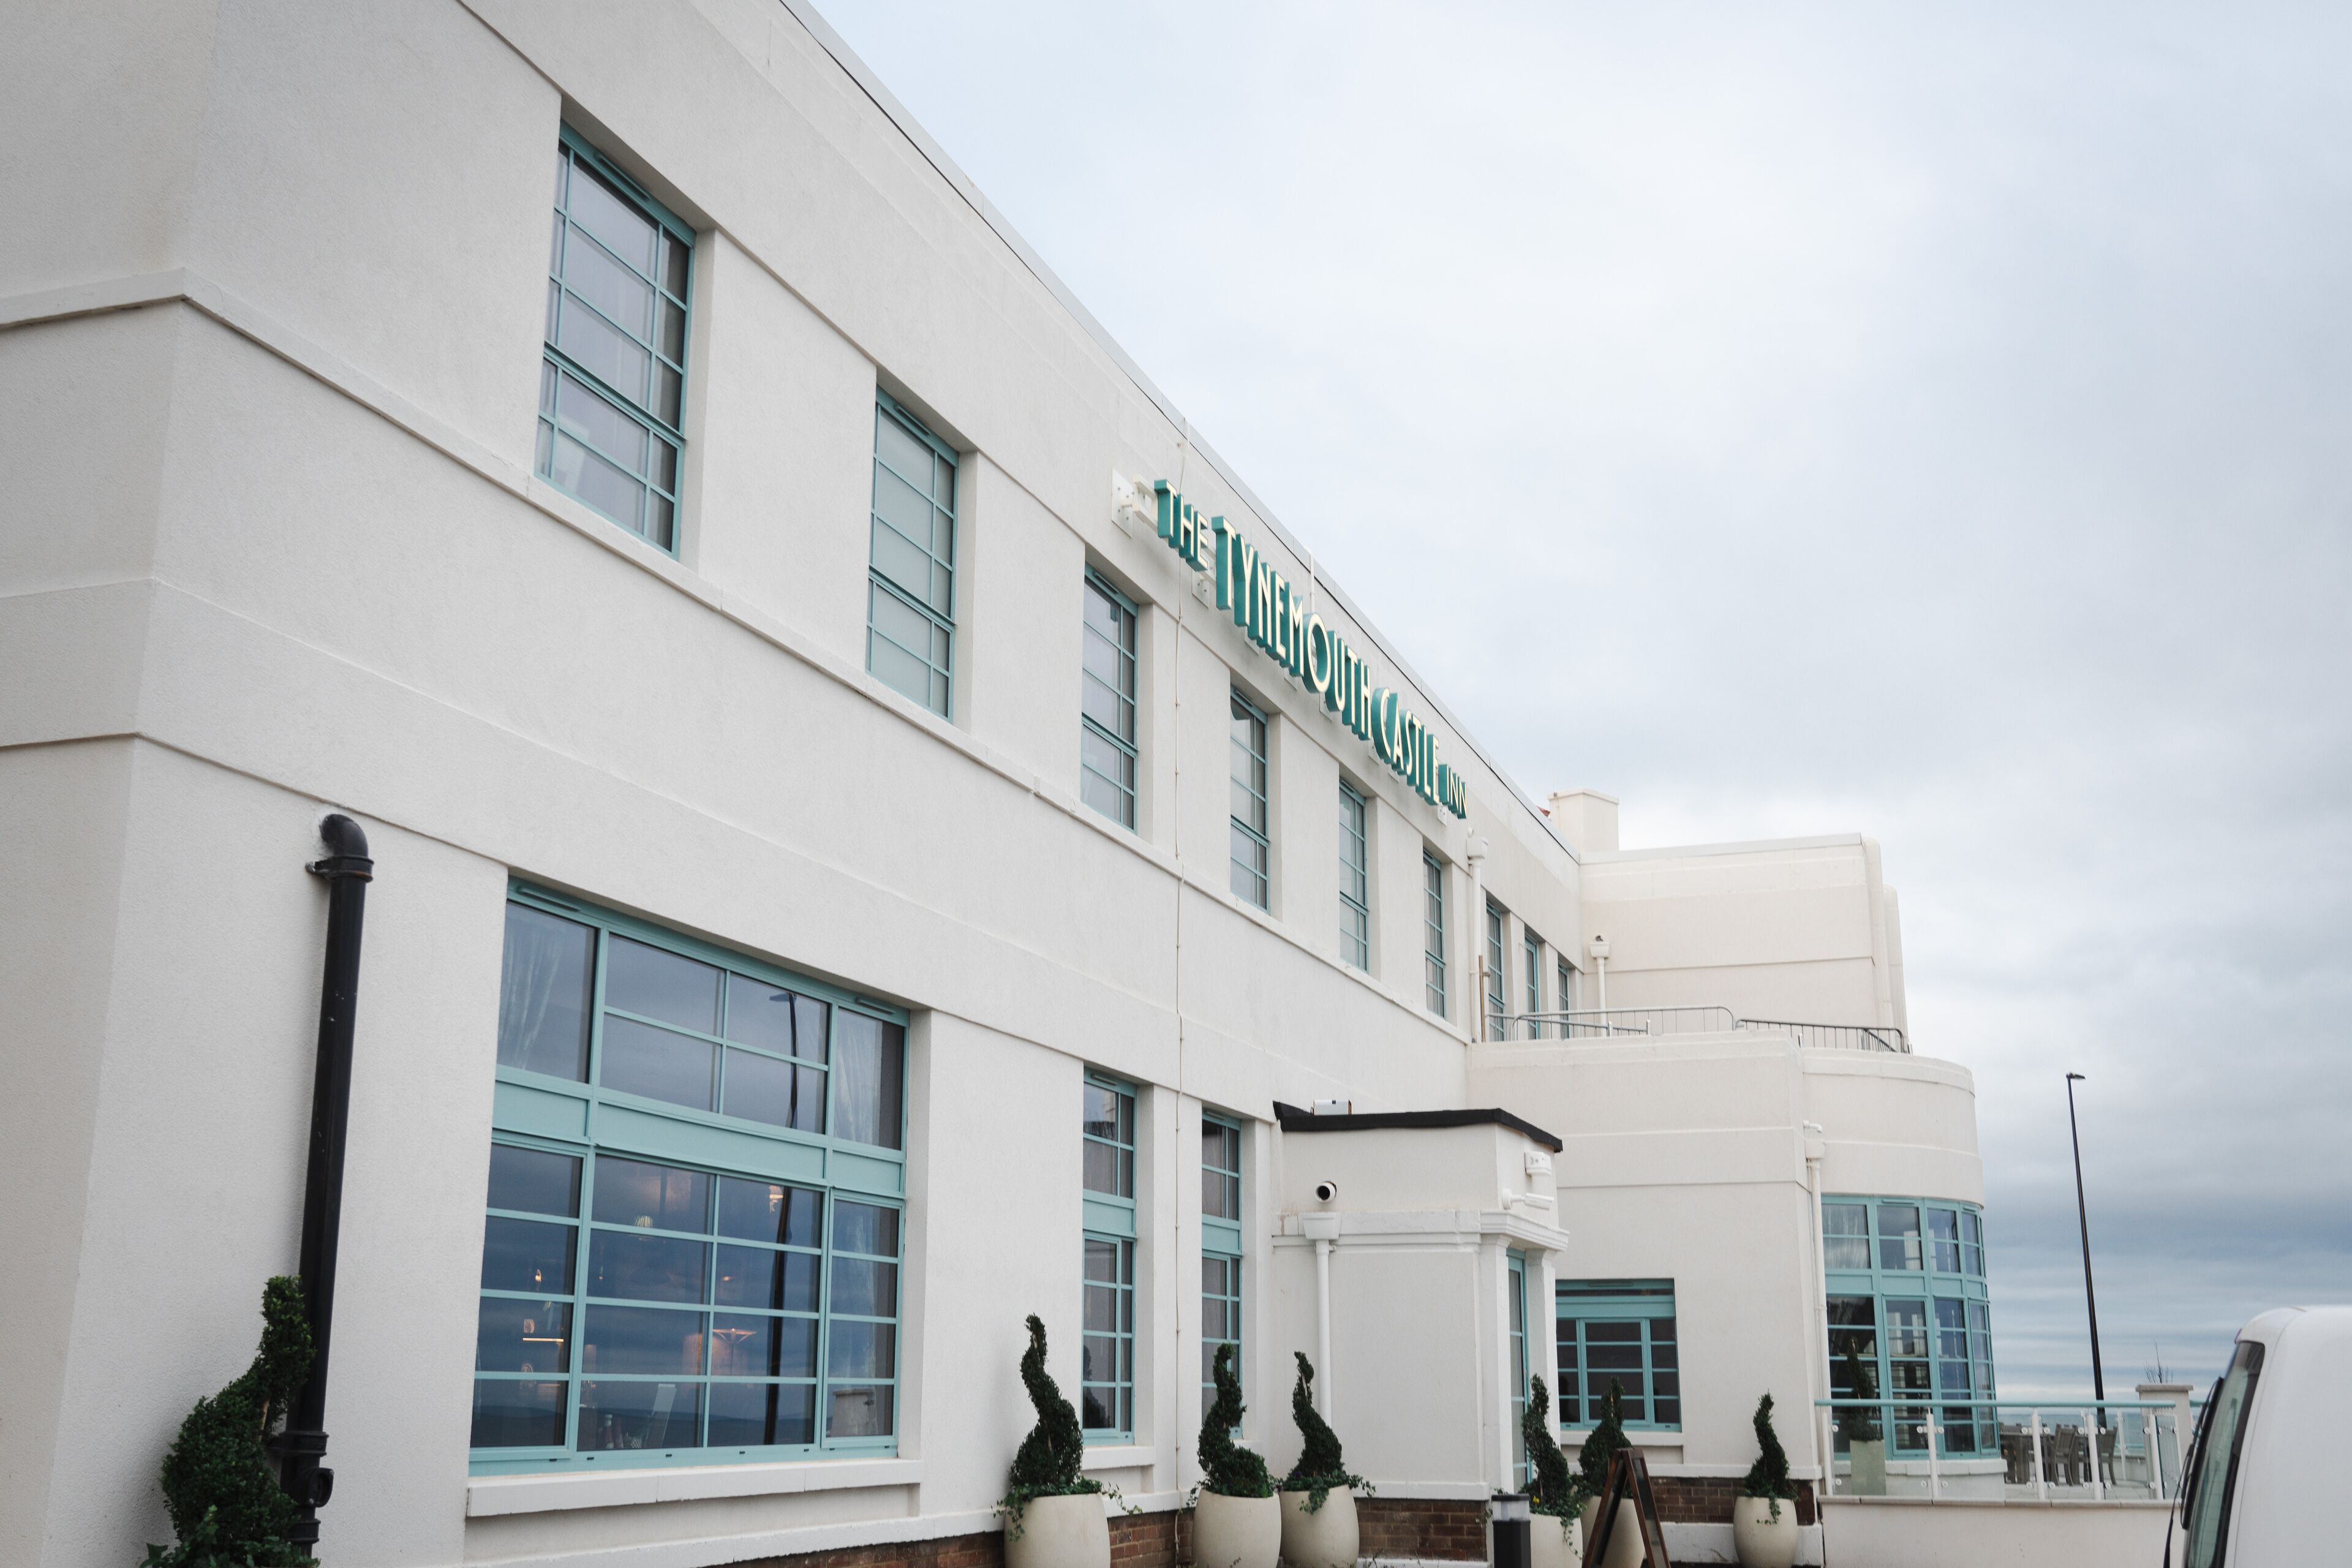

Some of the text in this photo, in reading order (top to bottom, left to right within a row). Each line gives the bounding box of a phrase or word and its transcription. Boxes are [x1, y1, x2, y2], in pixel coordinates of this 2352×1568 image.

[1155, 479, 1467, 819] THE TYNEMOUTH CASTLE INN
